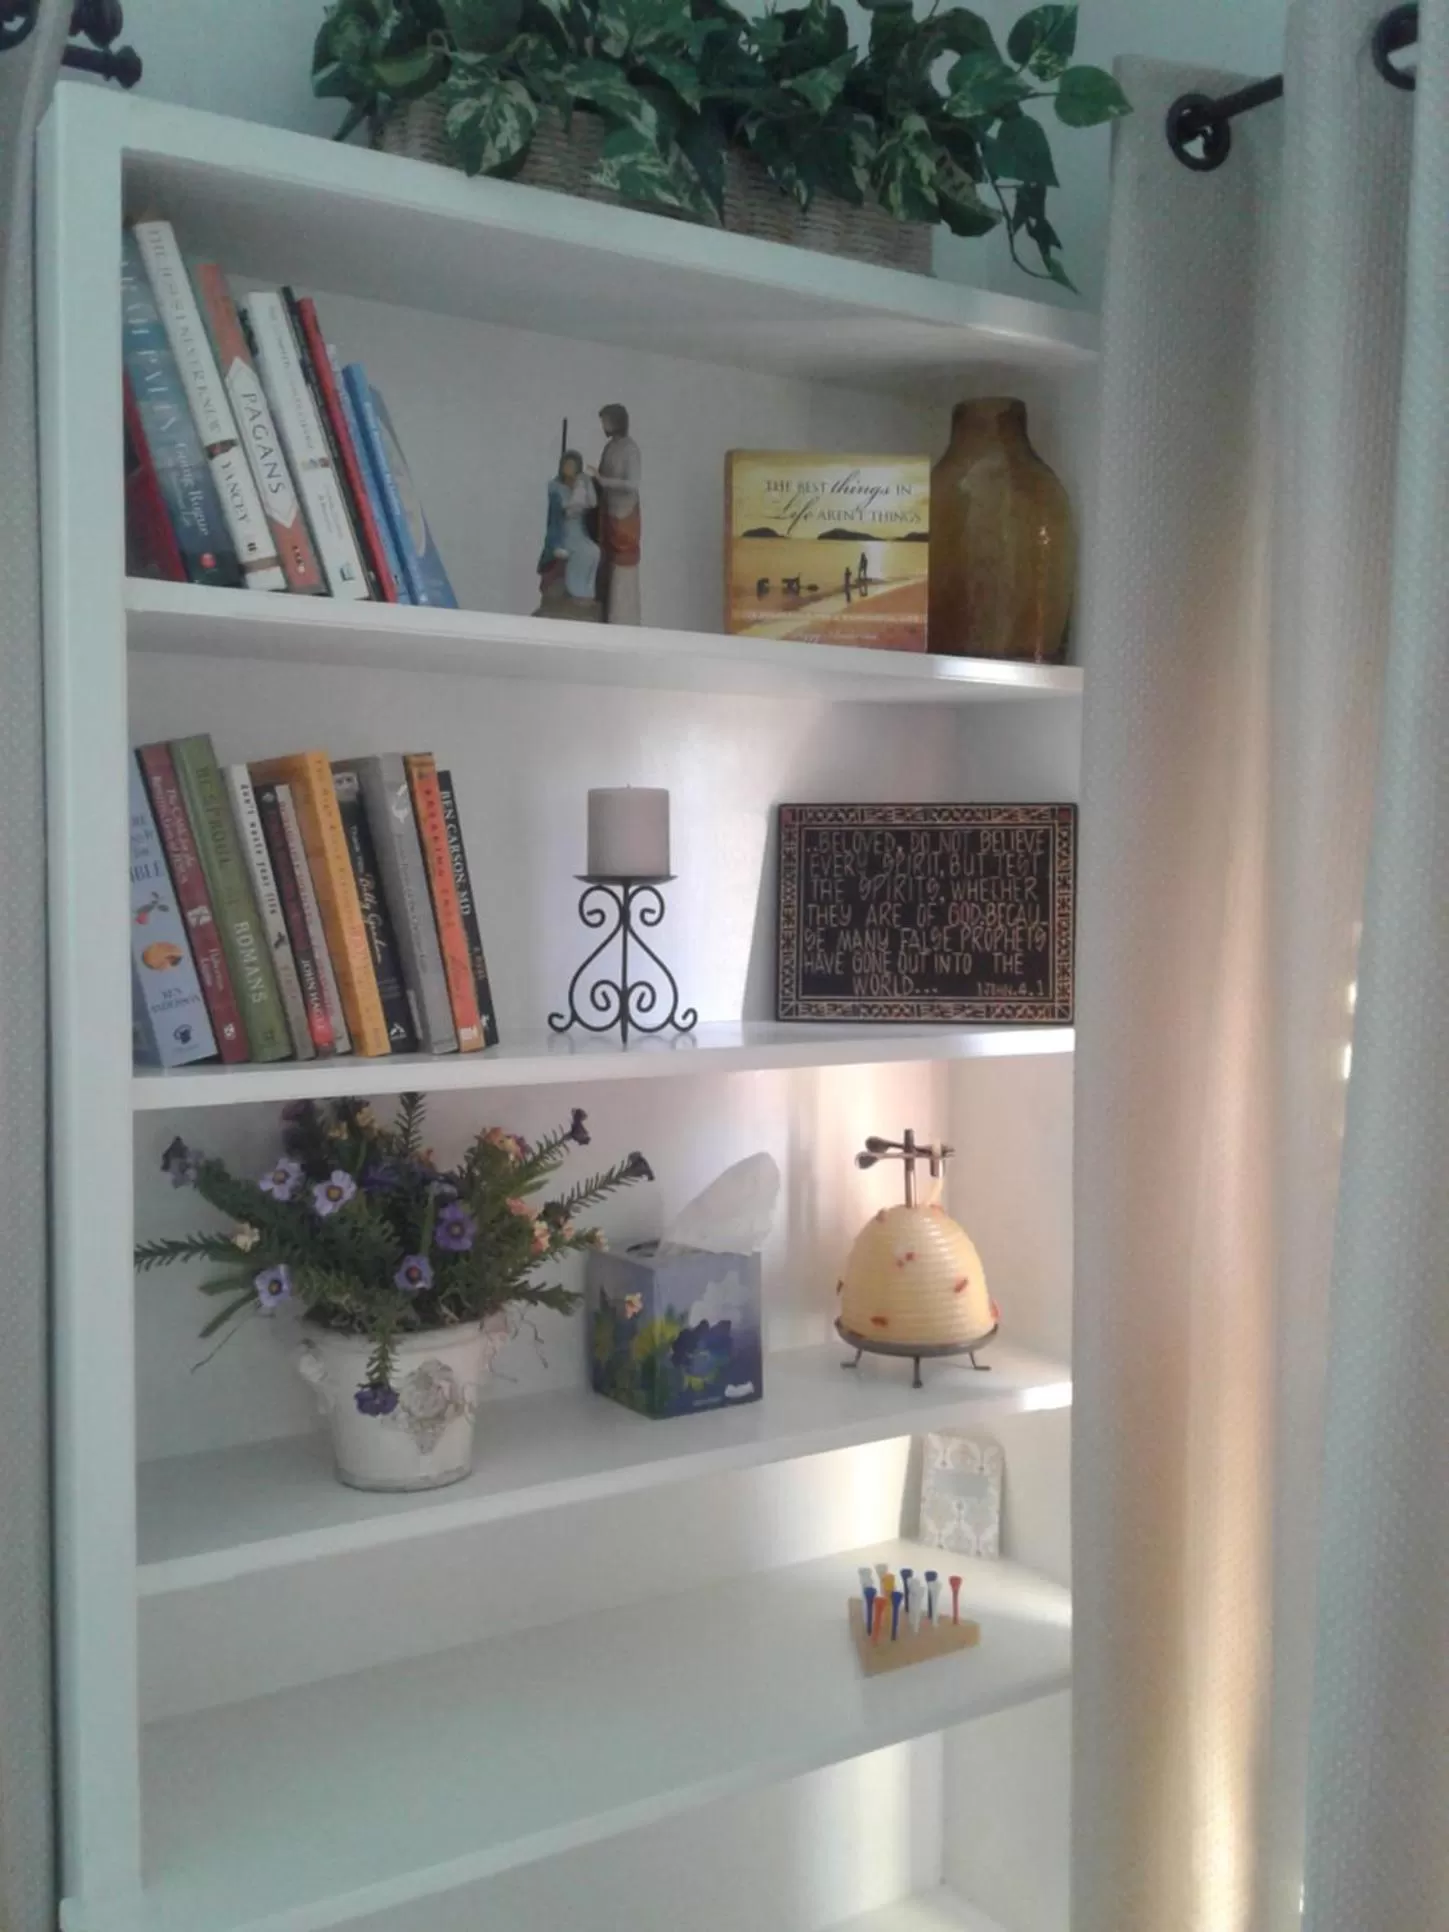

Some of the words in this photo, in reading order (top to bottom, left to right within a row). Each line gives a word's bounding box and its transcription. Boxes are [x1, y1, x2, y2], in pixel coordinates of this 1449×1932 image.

[237, 389, 288, 496] PAGANS
[766, 479, 790, 493] THE
[797, 481, 825, 494] BEST
[830, 469, 890, 508] things
[896, 483, 912, 496] IN
[871, 509, 922, 524] THINGS
[440, 789, 455, 820] BEN
[457, 889, 472, 915] MD
[910, 832, 930, 852] DO
[940, 831, 973, 853] NOT
[980, 830, 1044, 853] BELIEVE
[950, 852, 984, 876] BUT
[993, 852, 1040, 876] TEST
[811, 878, 845, 900] THE
[951, 876, 1038, 902] WHETHER
[807, 903, 852, 927] THEY
[865, 902, 902, 927] ARE
[916, 902, 937, 927] OF
[836, 928, 889, 951] MANY
[900, 927, 951, 954] FALSE
[960, 924, 1047, 952] PROPHETS
[232, 920, 268, 1004] ROMANS
[804, 952, 844, 975] HAVE
[852, 951, 892, 975] GONE
[898, 950, 928, 975] OUT
[992, 952, 1024, 975] THE
